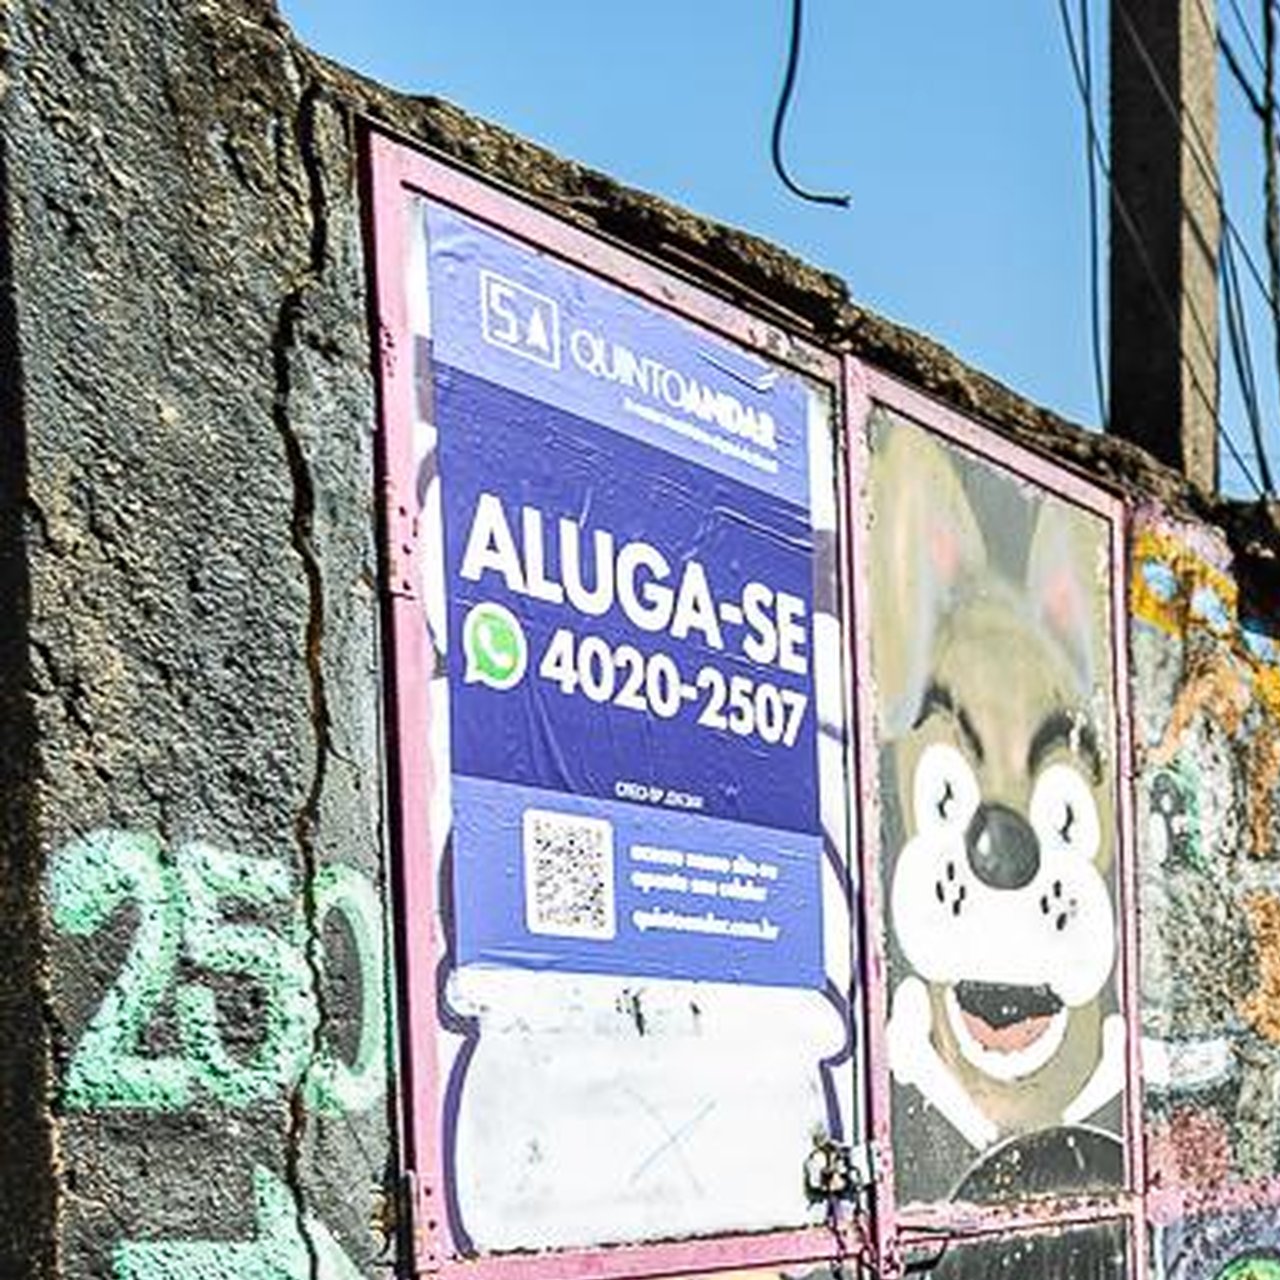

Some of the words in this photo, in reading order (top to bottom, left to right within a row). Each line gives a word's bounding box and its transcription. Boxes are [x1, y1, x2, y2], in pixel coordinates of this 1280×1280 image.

[570, 328, 778, 451] QUINTOANDAR
[460, 493, 808, 675] ALUGA-SE
[540, 629, 808, 748] 4020-2507
[46, 829, 389, 1118] 250
